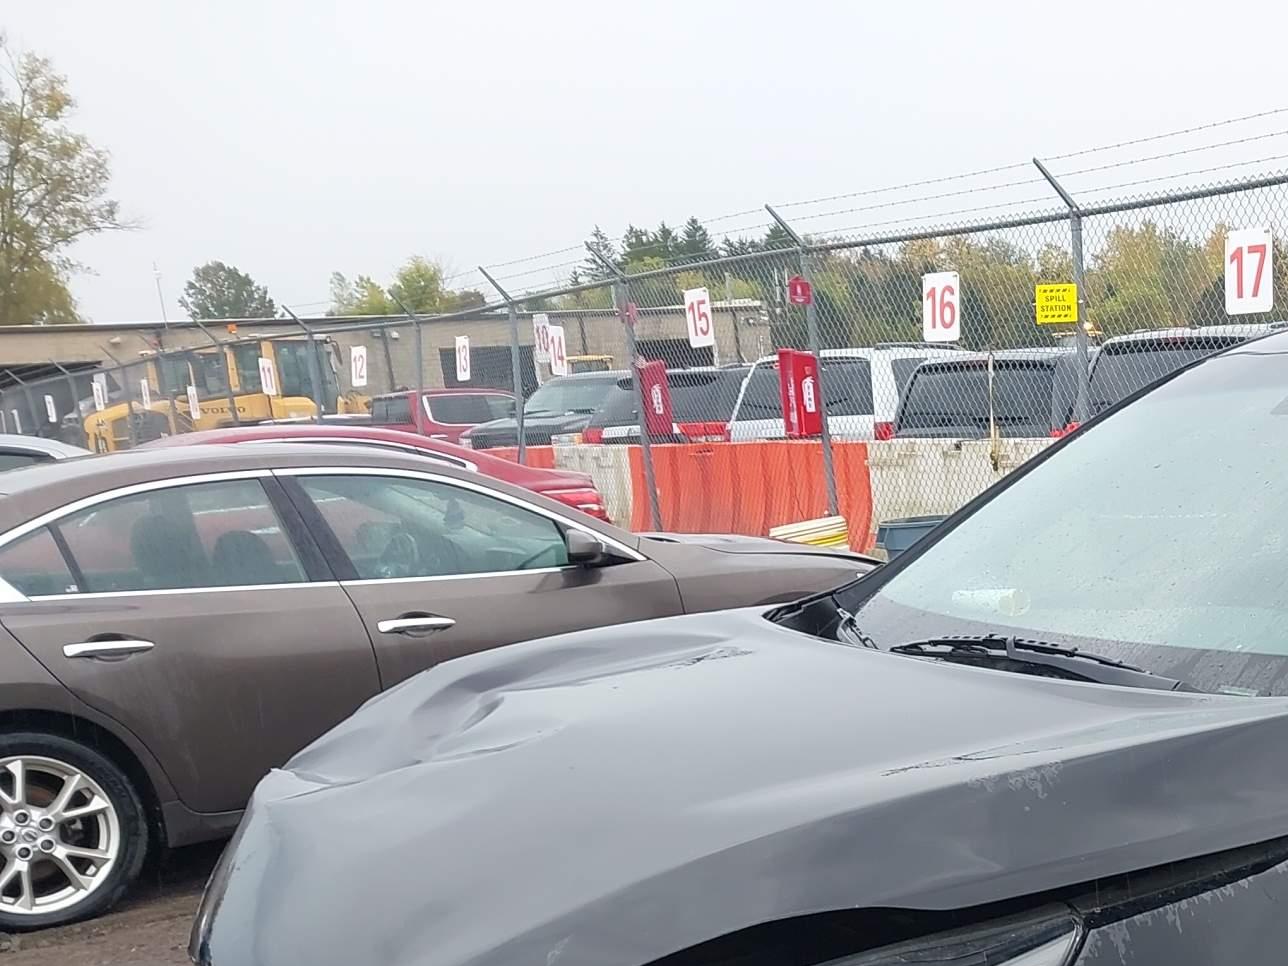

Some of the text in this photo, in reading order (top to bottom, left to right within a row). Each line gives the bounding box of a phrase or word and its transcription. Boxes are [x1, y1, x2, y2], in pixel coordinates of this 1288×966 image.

[1229, 243, 1267, 299] 17
[688, 299, 710, 337] 15
[926, 285, 956, 329] 16
[1040, 304, 1072, 312] STATION
[535, 325, 550, 352] 10
[551, 335, 565, 367] 14
[353, 354, 365, 380] 12
[458, 345, 468, 374] 13
[262, 366, 274, 393] 11
